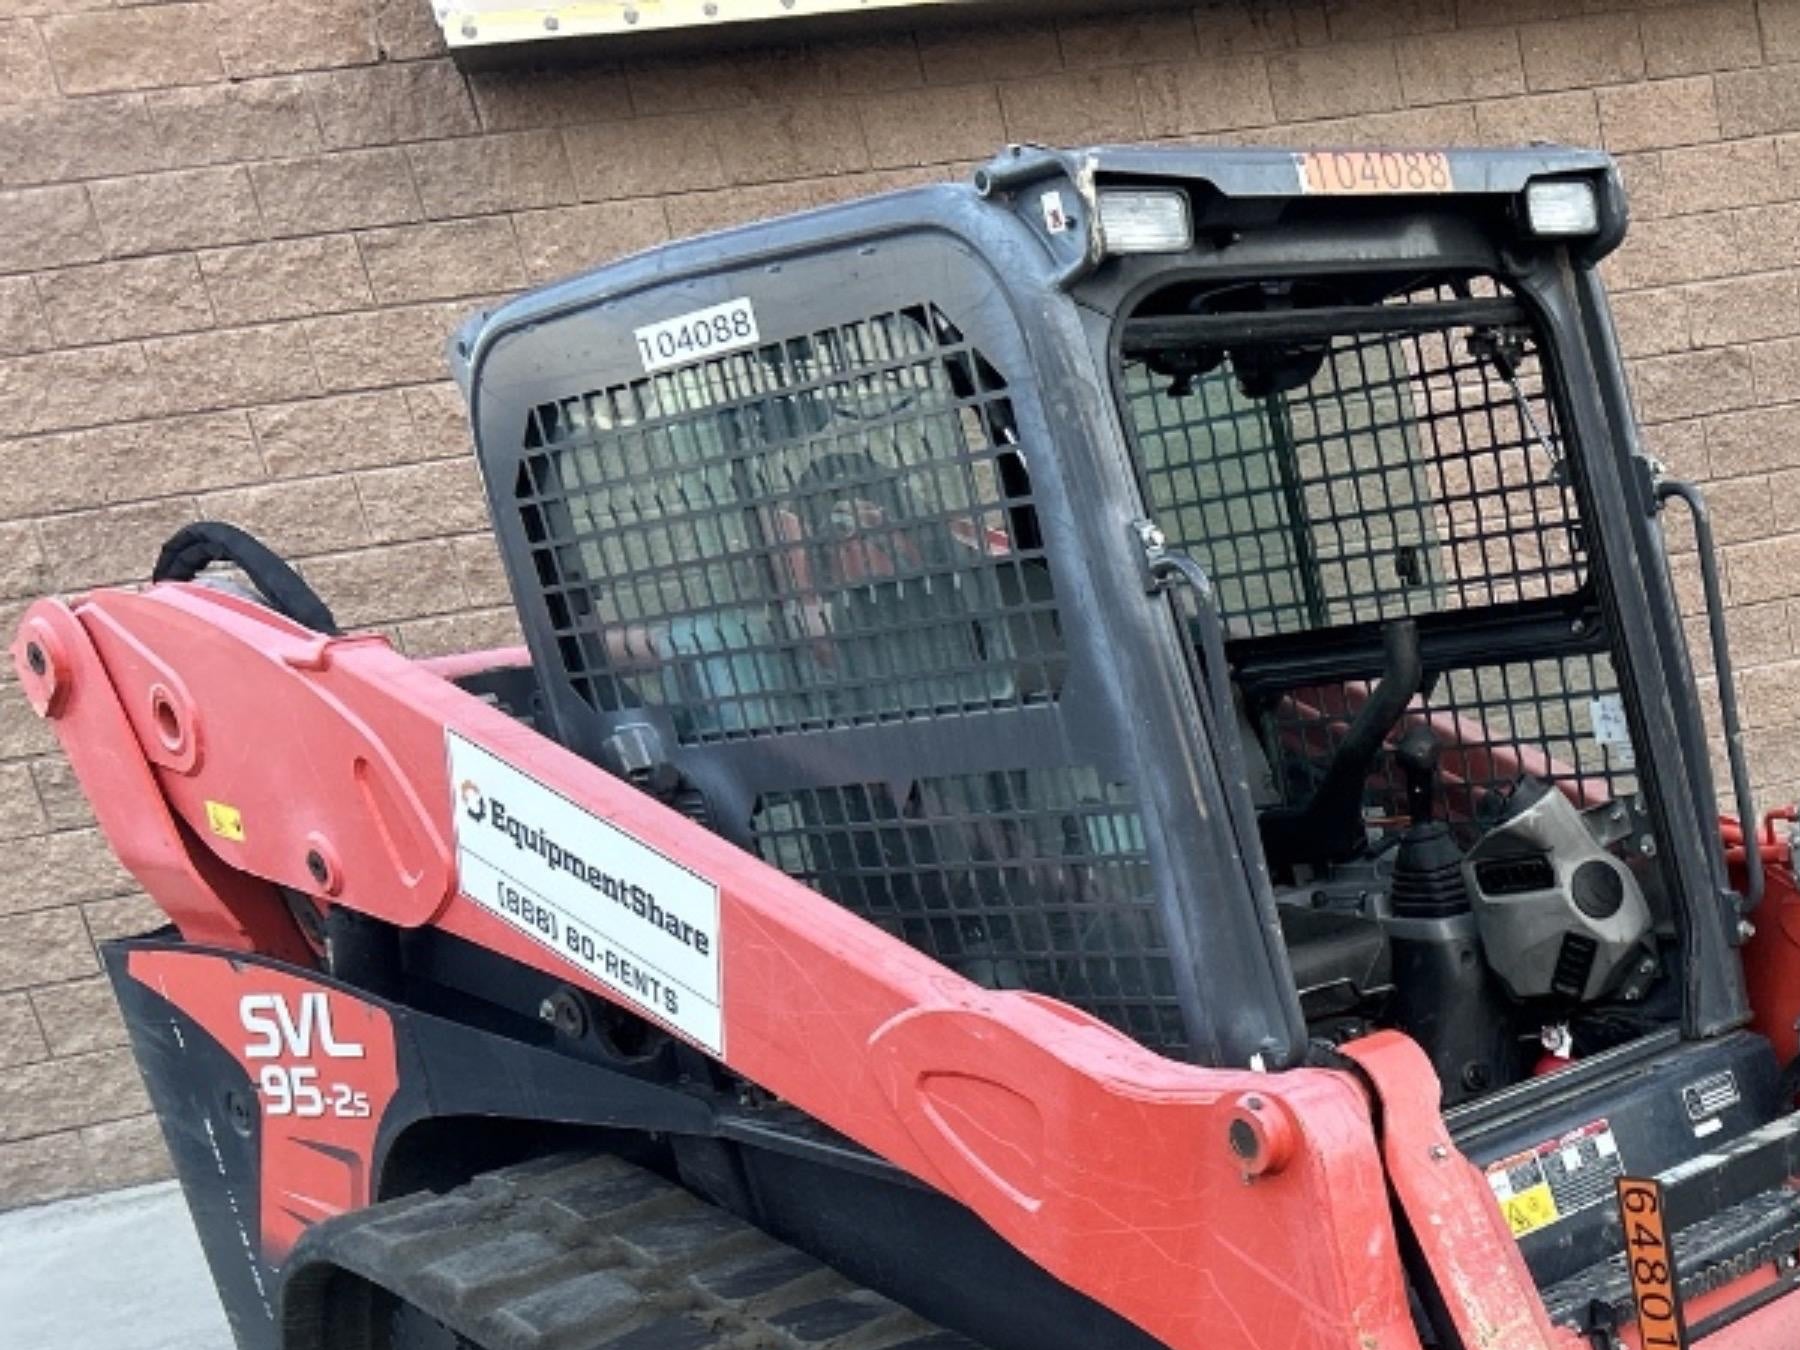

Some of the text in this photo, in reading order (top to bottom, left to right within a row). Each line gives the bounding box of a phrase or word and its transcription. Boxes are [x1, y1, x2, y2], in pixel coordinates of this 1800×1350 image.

[639, 308, 751, 363] 104088
[488, 797, 710, 955] EquipmentShare
[497, 881, 559, 940] (888)
[239, 991, 365, 1058] SVL
